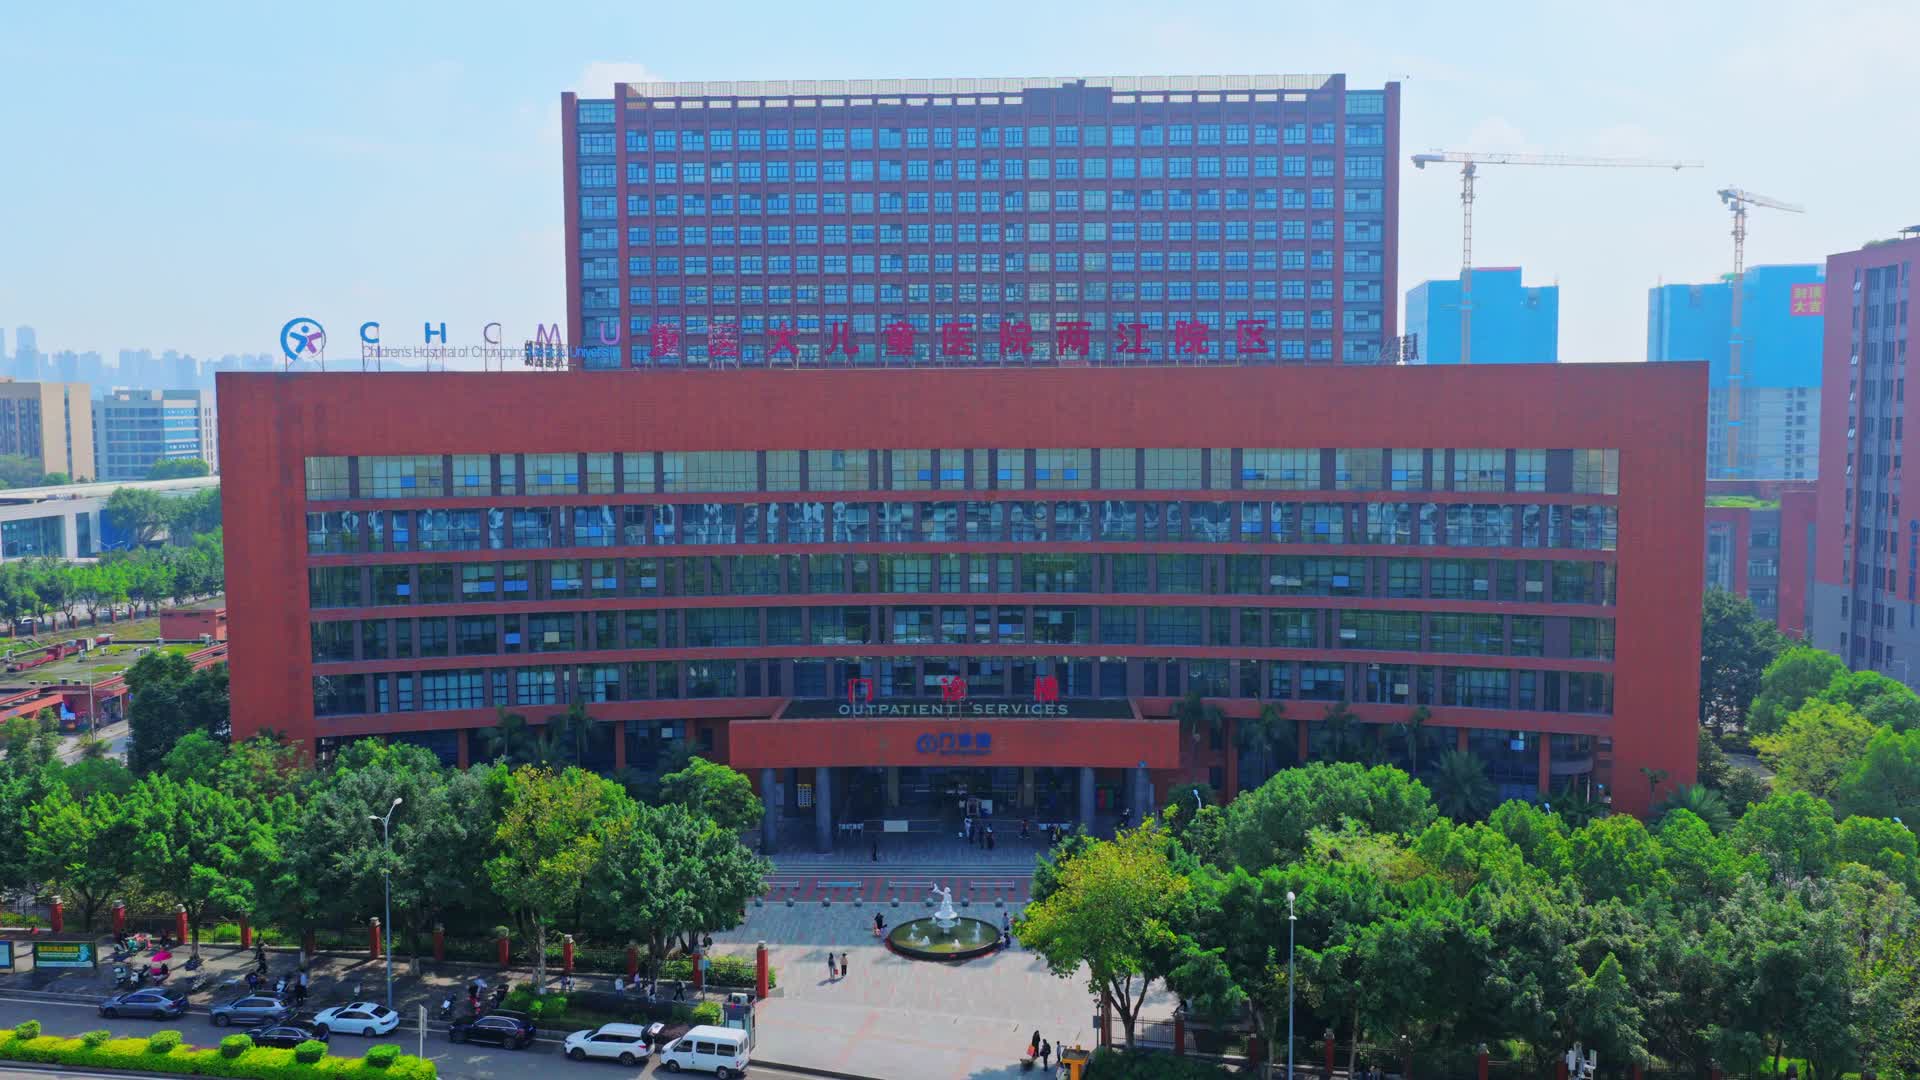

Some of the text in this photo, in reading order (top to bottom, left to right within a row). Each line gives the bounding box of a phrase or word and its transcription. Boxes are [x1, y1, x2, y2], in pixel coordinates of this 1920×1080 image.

[362, 345, 411, 358] Children's
[413, 345, 456, 360] Hospital
[457, 345, 468, 358] of
[471, 345, 526, 361] Chongqing
[838, 703, 1069, 716] OUTPATIENT SERVICES
